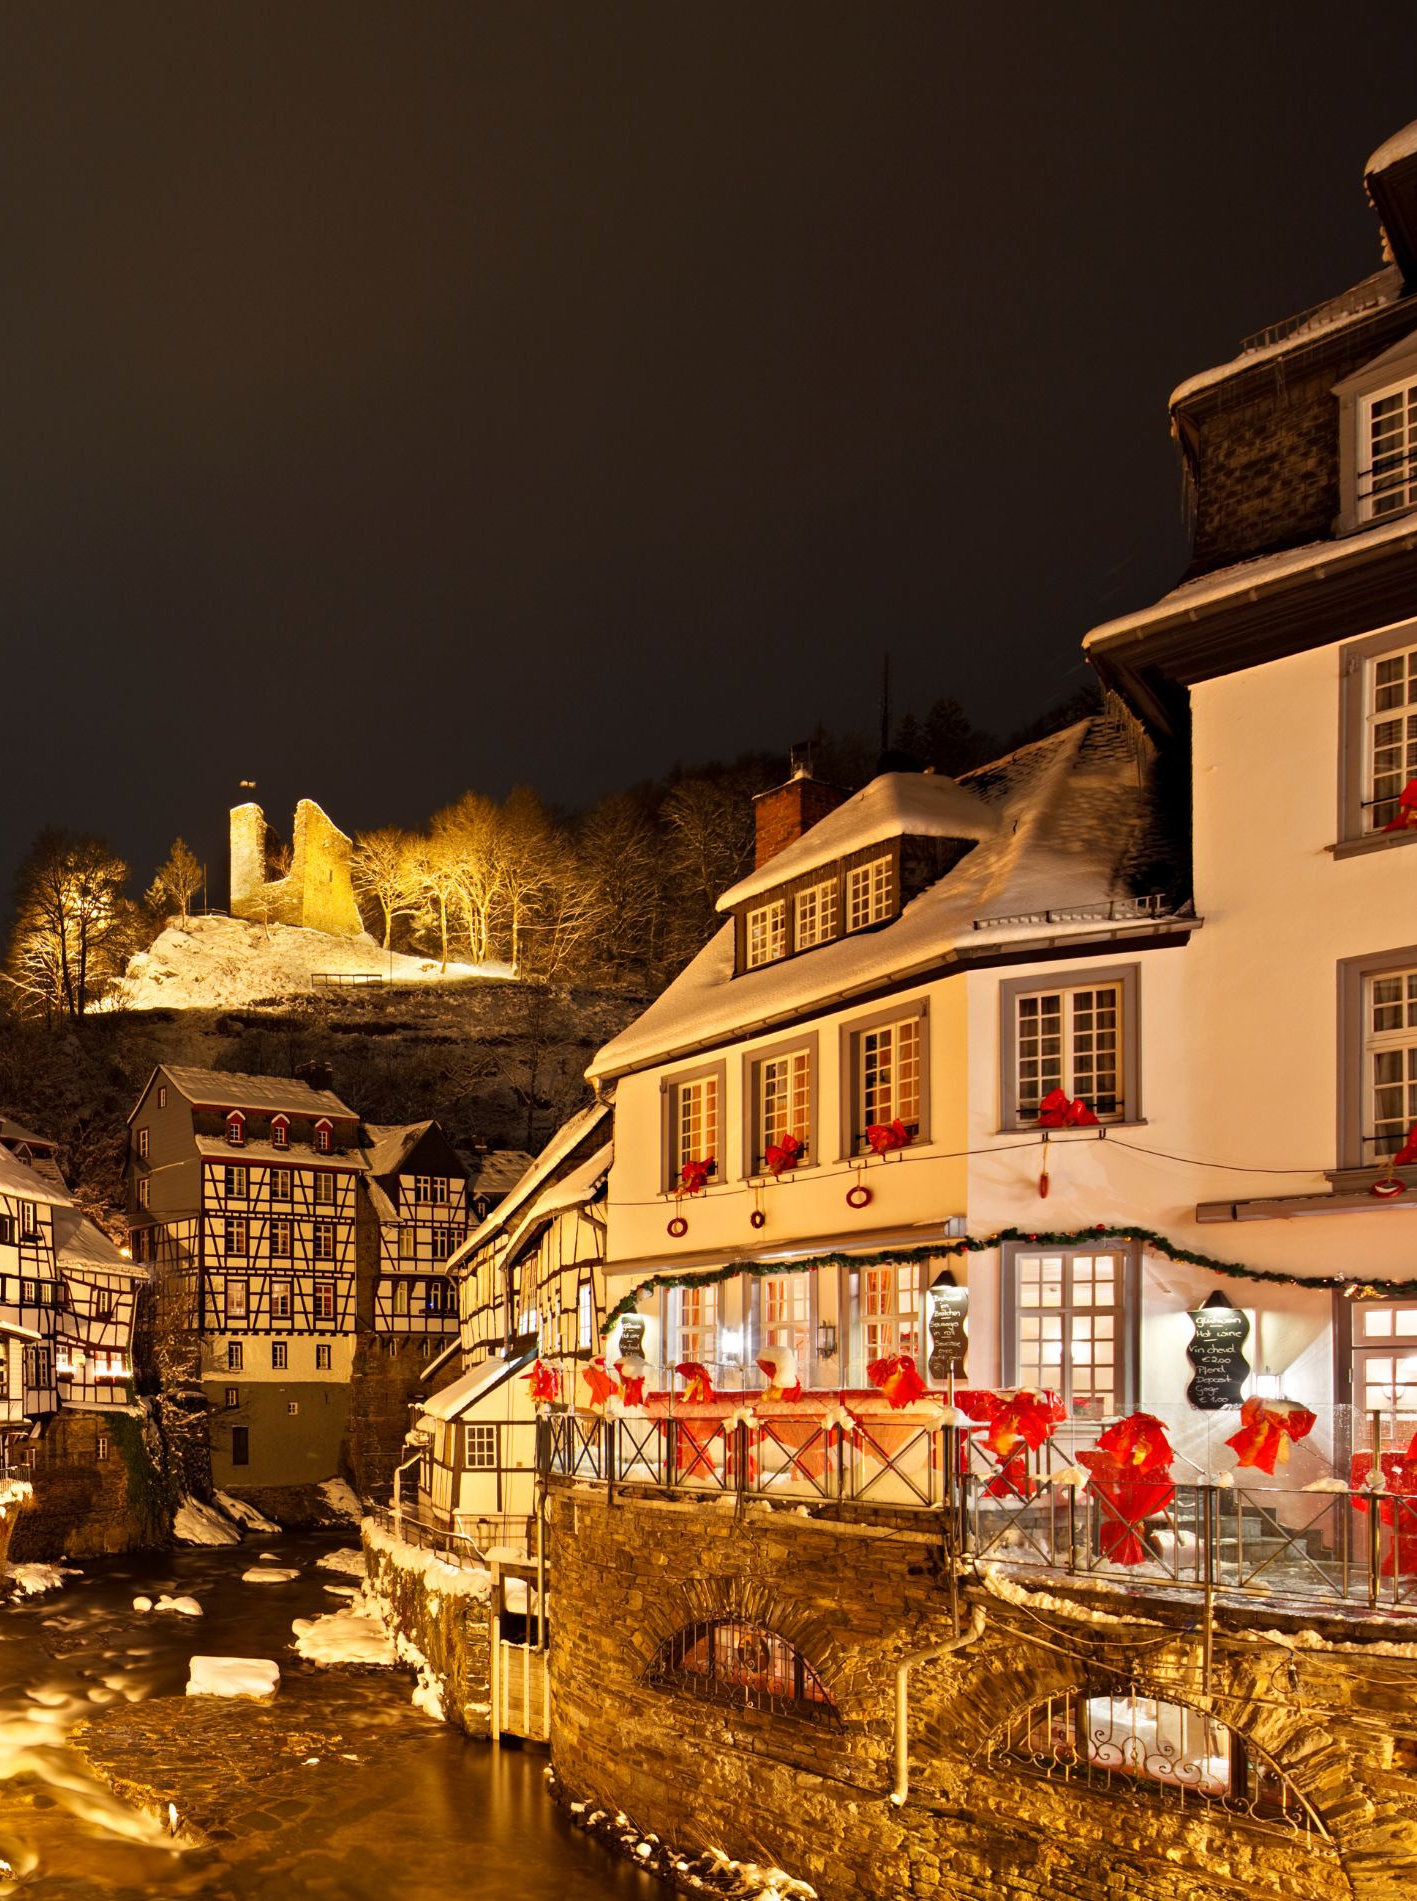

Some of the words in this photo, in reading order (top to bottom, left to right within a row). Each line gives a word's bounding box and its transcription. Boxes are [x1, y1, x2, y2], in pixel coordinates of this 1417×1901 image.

[1196, 1330, 1211, 1338] Hot
[1217, 1328, 1242, 1337] wine
[1188, 1345, 1204, 1353] Vin
[1207, 1344, 1235, 1354] chaud
[1196, 1365, 1226, 1374] Pfand
[1195, 1375, 1232, 1384] Deposit
